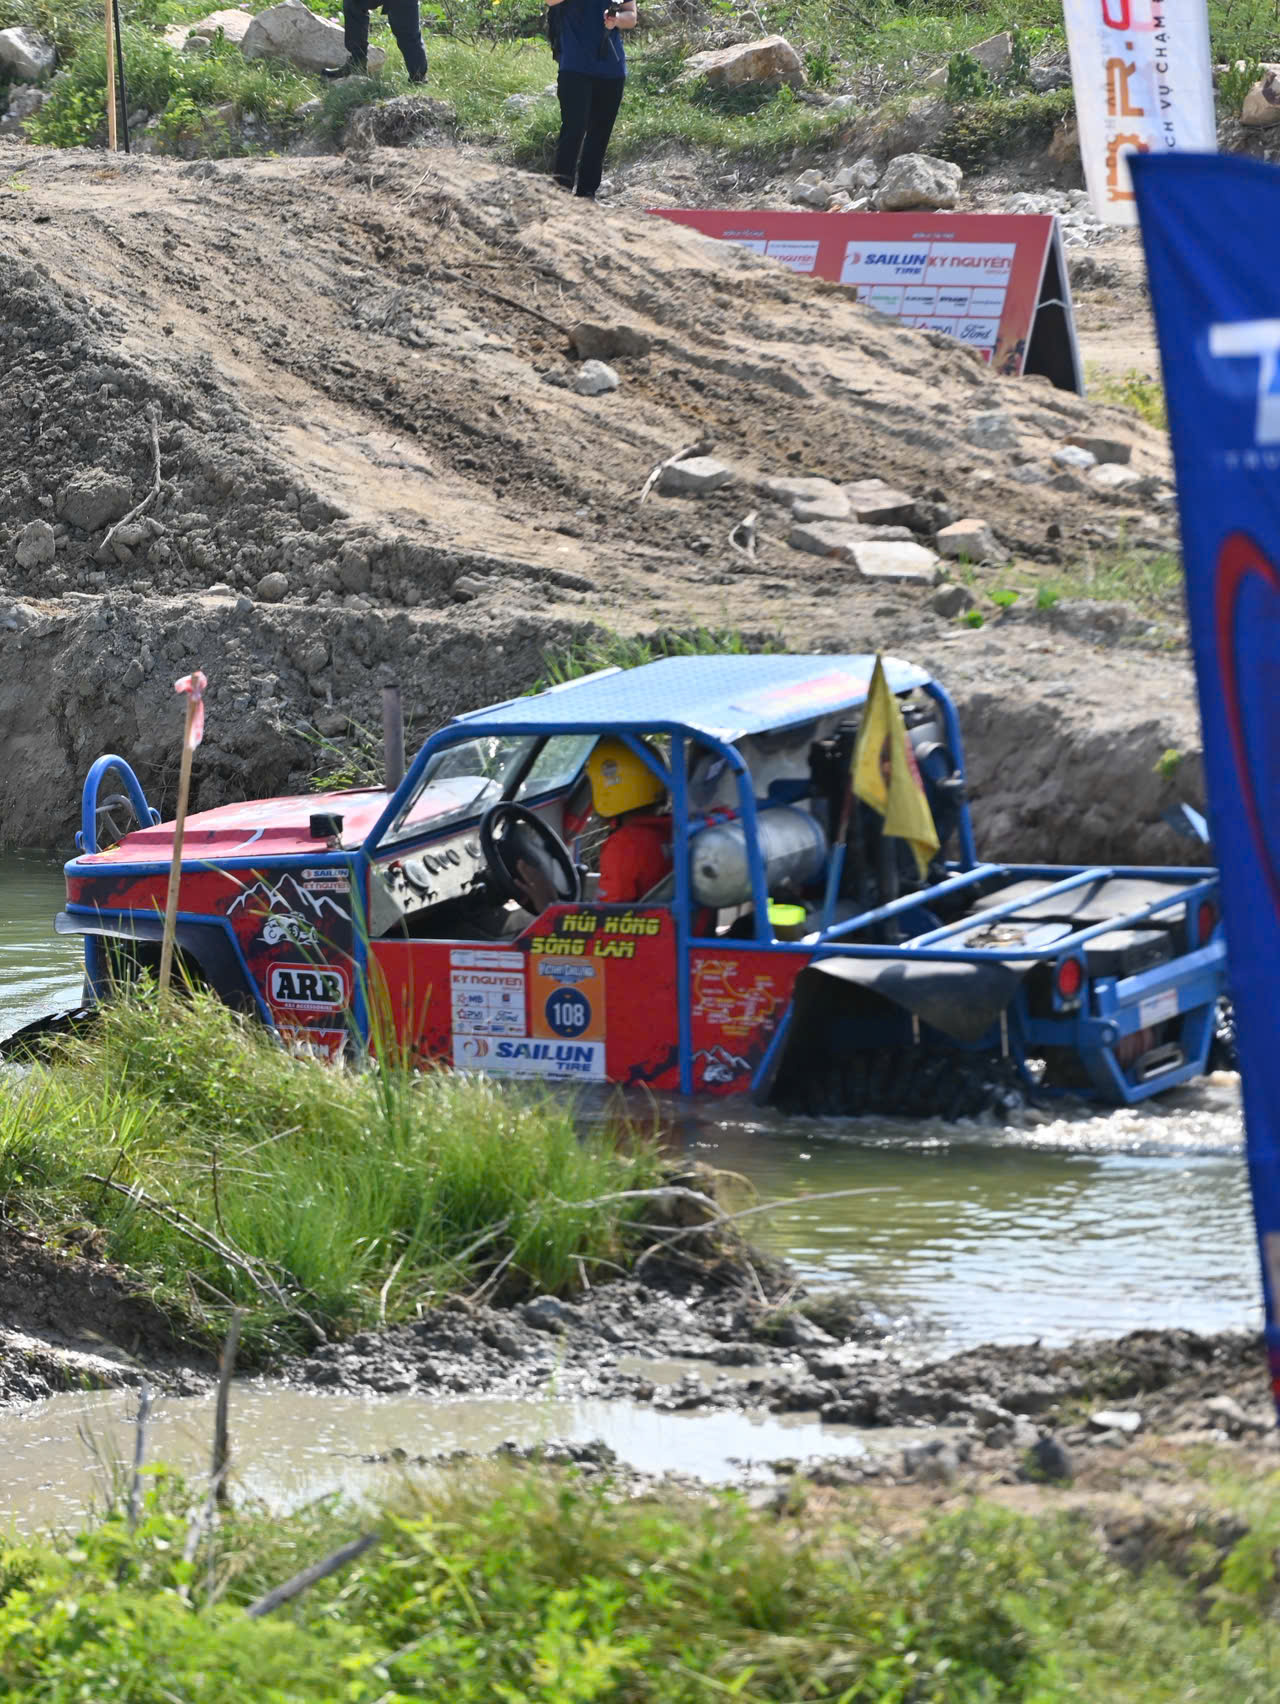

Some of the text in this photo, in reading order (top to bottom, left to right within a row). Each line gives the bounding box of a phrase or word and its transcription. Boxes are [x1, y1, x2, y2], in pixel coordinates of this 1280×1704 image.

[1153, 16, 1171, 74] CHẠM
[1159, 85, 1174, 110] VỤ
[864, 254, 928, 265] SAILUN
[894, 267, 922, 275] TIRE
[276, 971, 341, 1002] ARB
[553, 1003, 585, 1026] 108
[496, 1042, 594, 1062] SAILUN
[556, 1062, 592, 1072] TIRE
